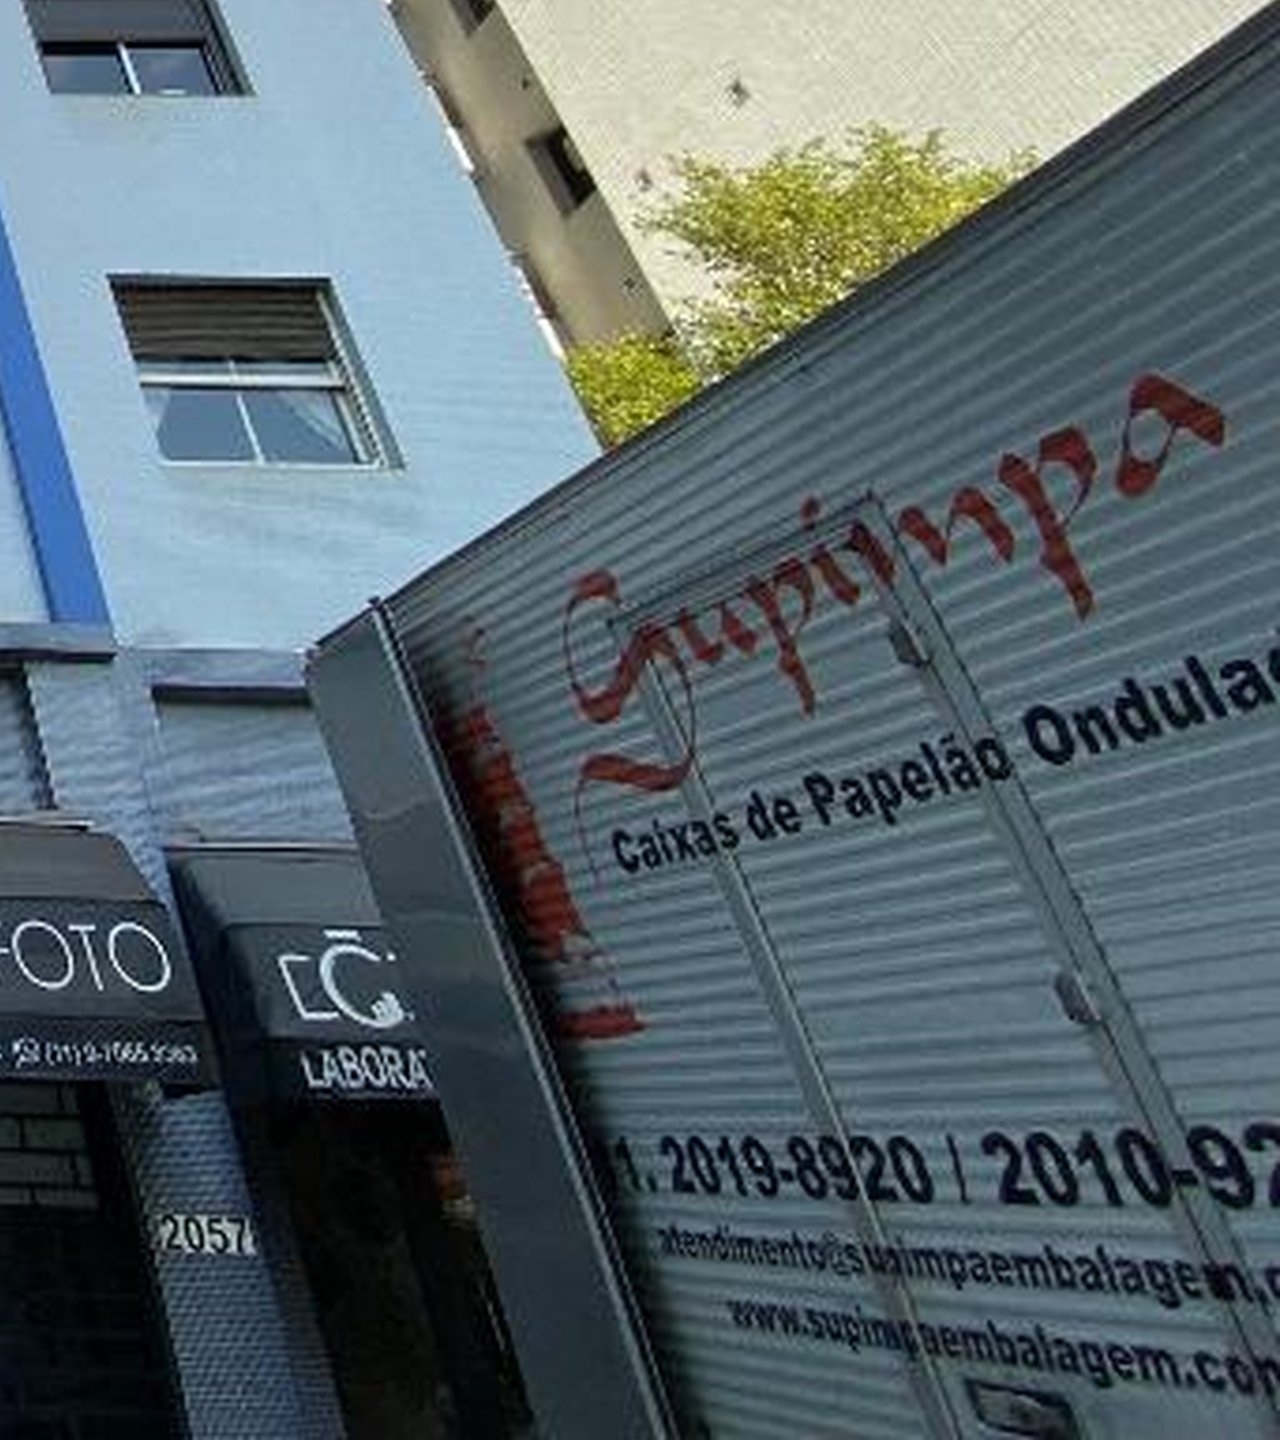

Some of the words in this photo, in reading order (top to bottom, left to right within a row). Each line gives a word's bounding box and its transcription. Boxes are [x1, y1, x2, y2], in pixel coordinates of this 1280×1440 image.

[611, 811, 740, 873] Caixas
[746, 790, 801, 841] de
[803, 732, 1016, 825] Papelão
[1022, 640, 1280, 765] Ondula
[300, 1047, 434, 1090] LABORA
[659, 1134, 935, 1205] 2019-8920
[160, 1215, 248, 1251] 2057
